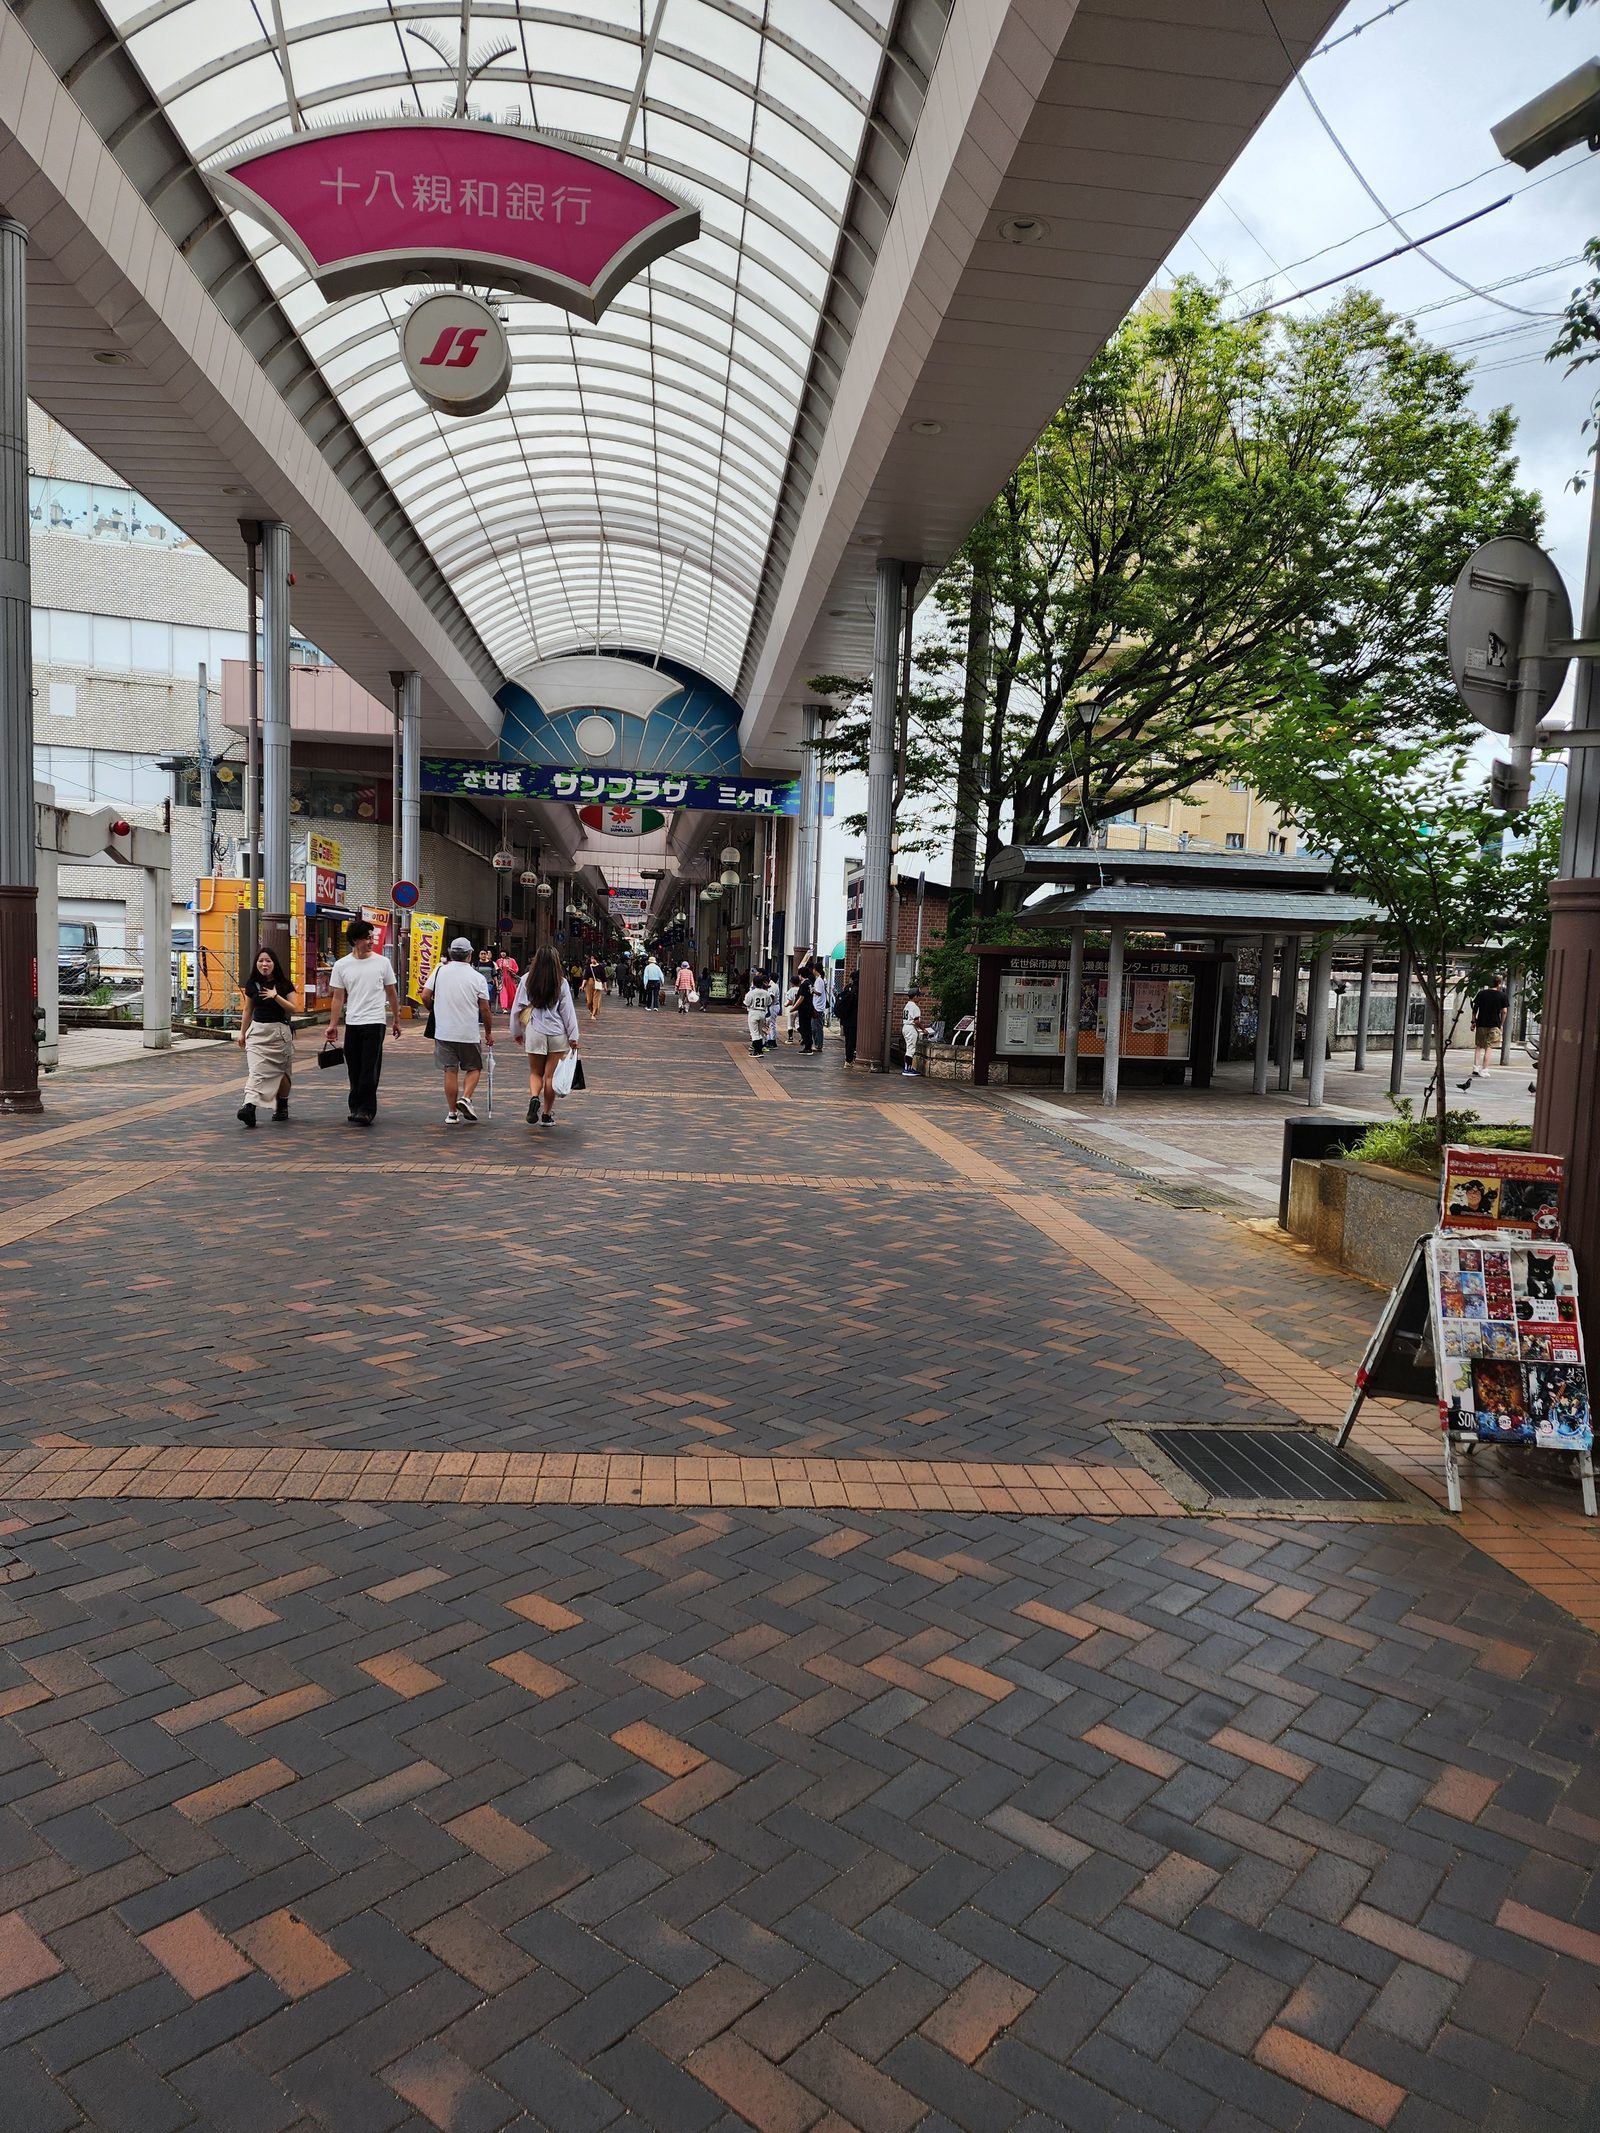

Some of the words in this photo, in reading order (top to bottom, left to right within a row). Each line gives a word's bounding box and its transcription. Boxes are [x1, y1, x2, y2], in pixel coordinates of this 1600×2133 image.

[320, 166, 592, 226] 十八親和銀行
[462, 770, 522, 792] させぼ
[553, 773, 688, 803] サンプラザ
[316, 874, 335, 900] 宝くじ
[755, 997, 765, 1008] 21
